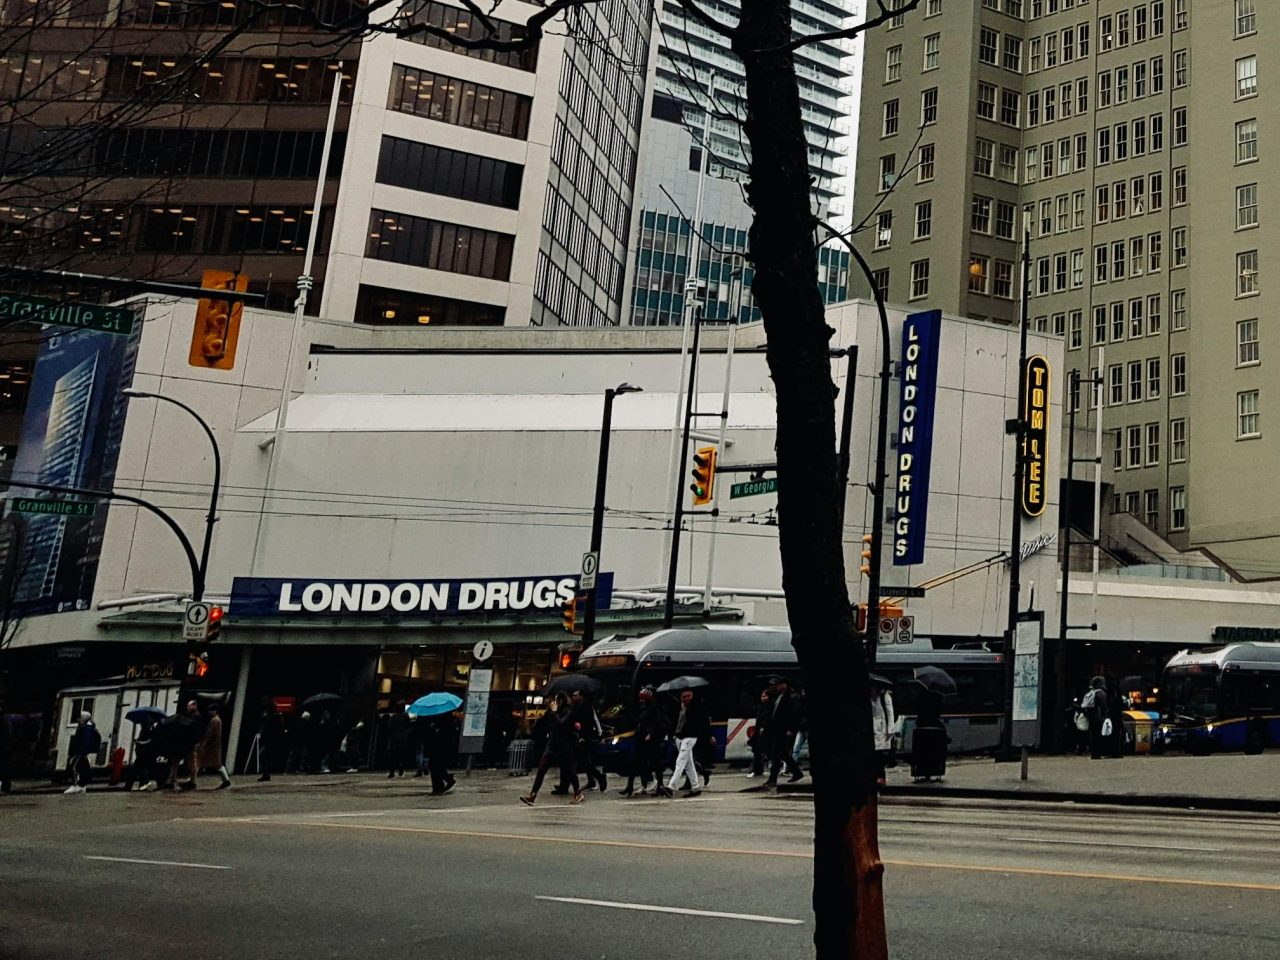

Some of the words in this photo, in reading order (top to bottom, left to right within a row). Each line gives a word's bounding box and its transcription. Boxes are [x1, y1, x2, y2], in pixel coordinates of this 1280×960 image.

[102, 312, 121, 330] St
[902, 324, 919, 444] LONDON
[1030, 367, 1045, 430] TOM
[734, 487, 741, 496] W
[743, 480, 774, 494] Georgia
[1029, 439, 1042, 504] LEE
[18, 500, 72, 514] Granville
[76, 504, 88, 514] St
[896, 453, 914, 557] DRUGS
[278, 581, 450, 613] LONDON
[458, 578, 578, 611] DRUGS
